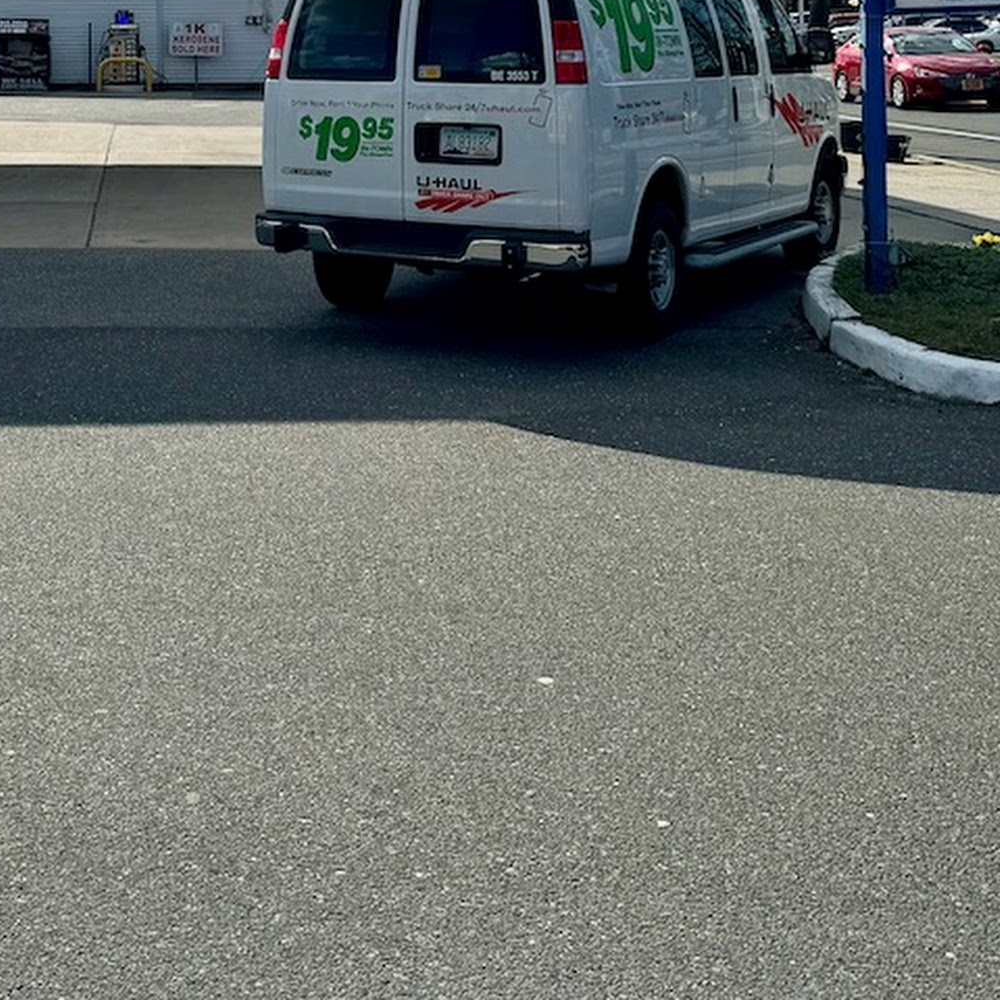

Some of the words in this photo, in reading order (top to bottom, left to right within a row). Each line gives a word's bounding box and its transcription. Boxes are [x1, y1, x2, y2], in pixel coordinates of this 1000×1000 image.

[173, 36, 220, 45] KEROSENE
[172, 45, 195, 54] SOLD
[197, 45, 220, 54] HERE
[407, 101, 433, 111] Truck
[435, 102, 462, 112] Share
[416, 176, 483, 191] U-HAUL
